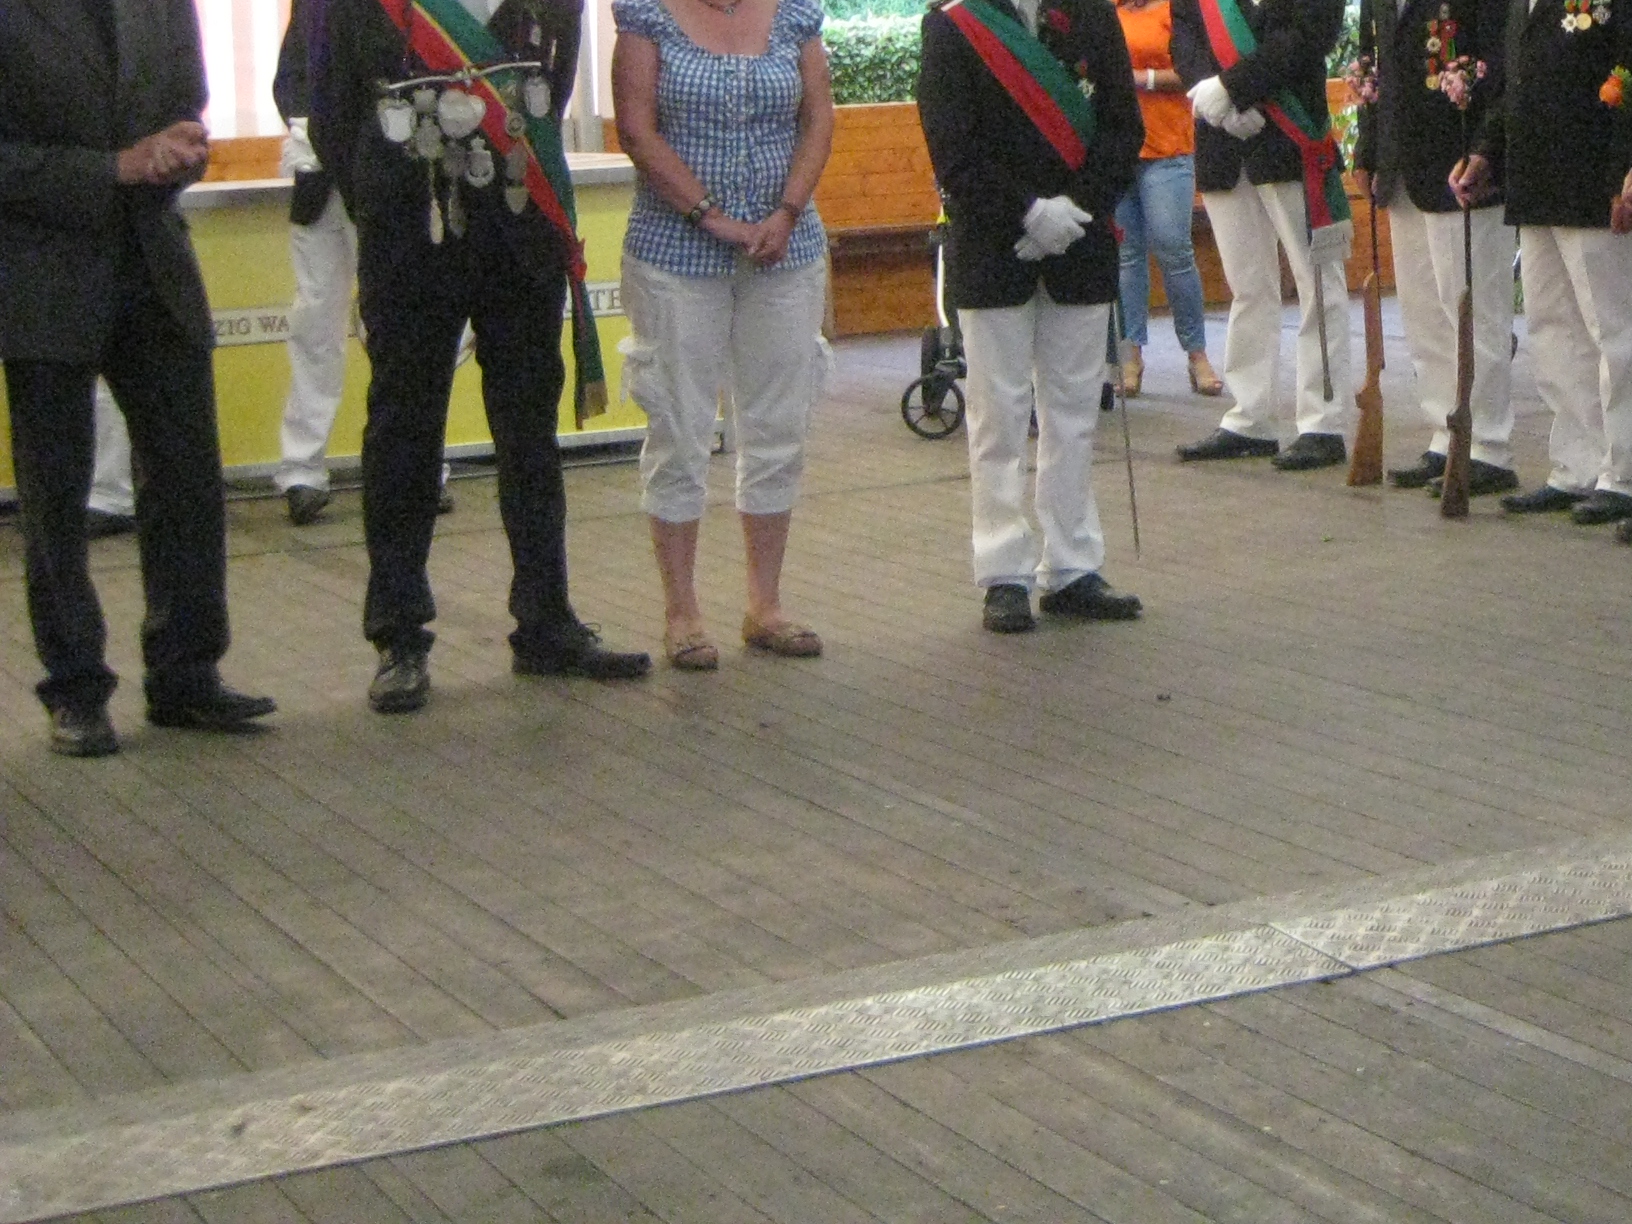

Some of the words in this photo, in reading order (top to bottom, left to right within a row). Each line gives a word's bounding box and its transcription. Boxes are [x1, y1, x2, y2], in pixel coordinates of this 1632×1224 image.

[588, 287, 621, 310] TE
[215, 317, 251, 336] ZIG
[257, 314, 290, 333] WA
